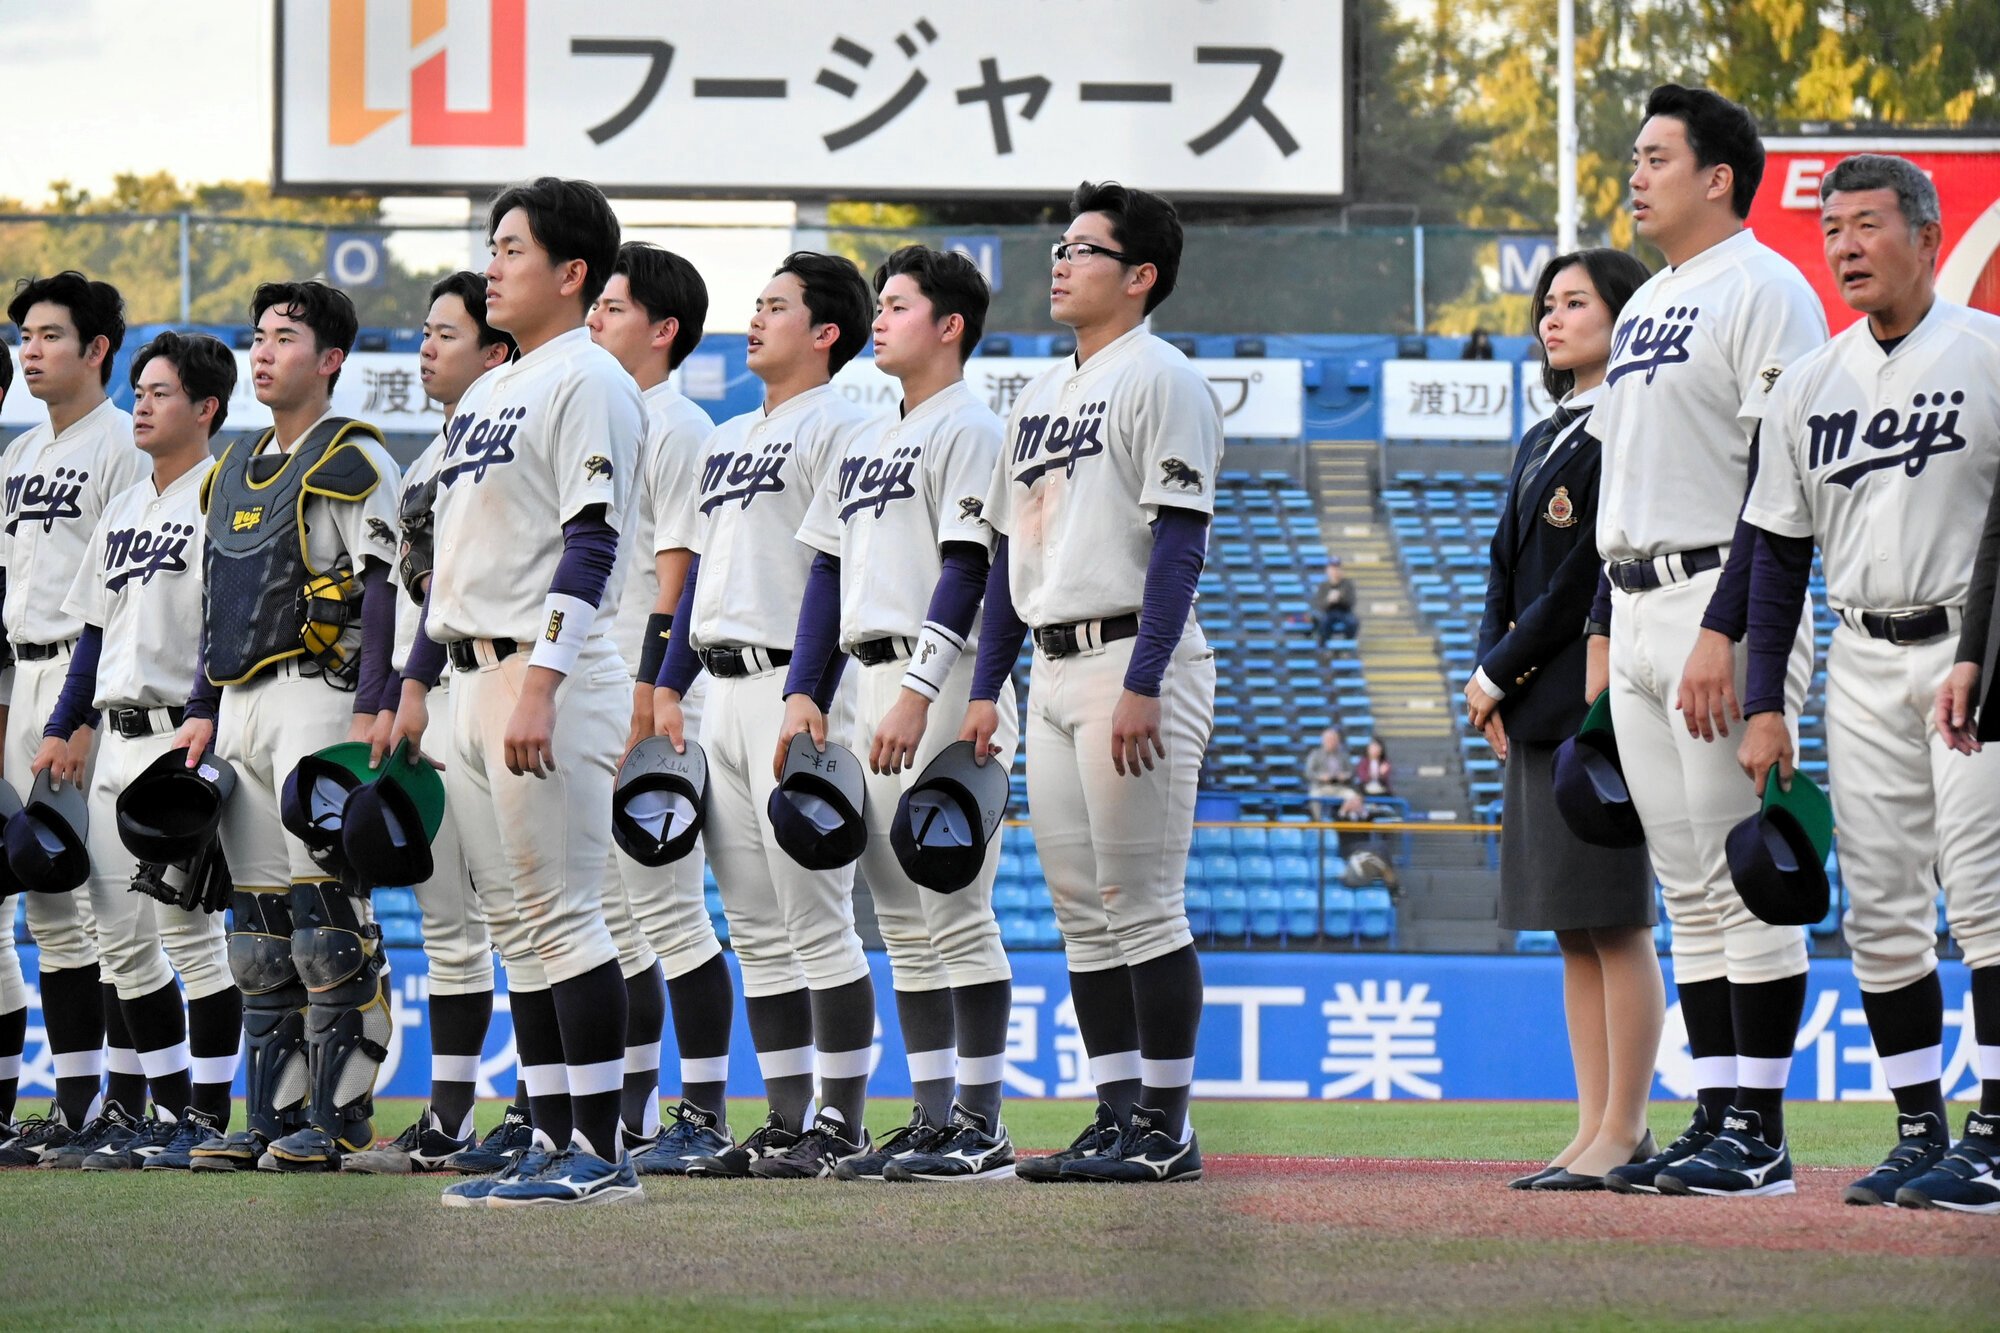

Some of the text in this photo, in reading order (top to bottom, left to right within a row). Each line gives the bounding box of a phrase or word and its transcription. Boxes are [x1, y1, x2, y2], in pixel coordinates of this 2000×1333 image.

[569, 17, 1300, 158] フージャース
[1502, 243, 1551, 290] M
[801, 752, 838, 774] 日本一
